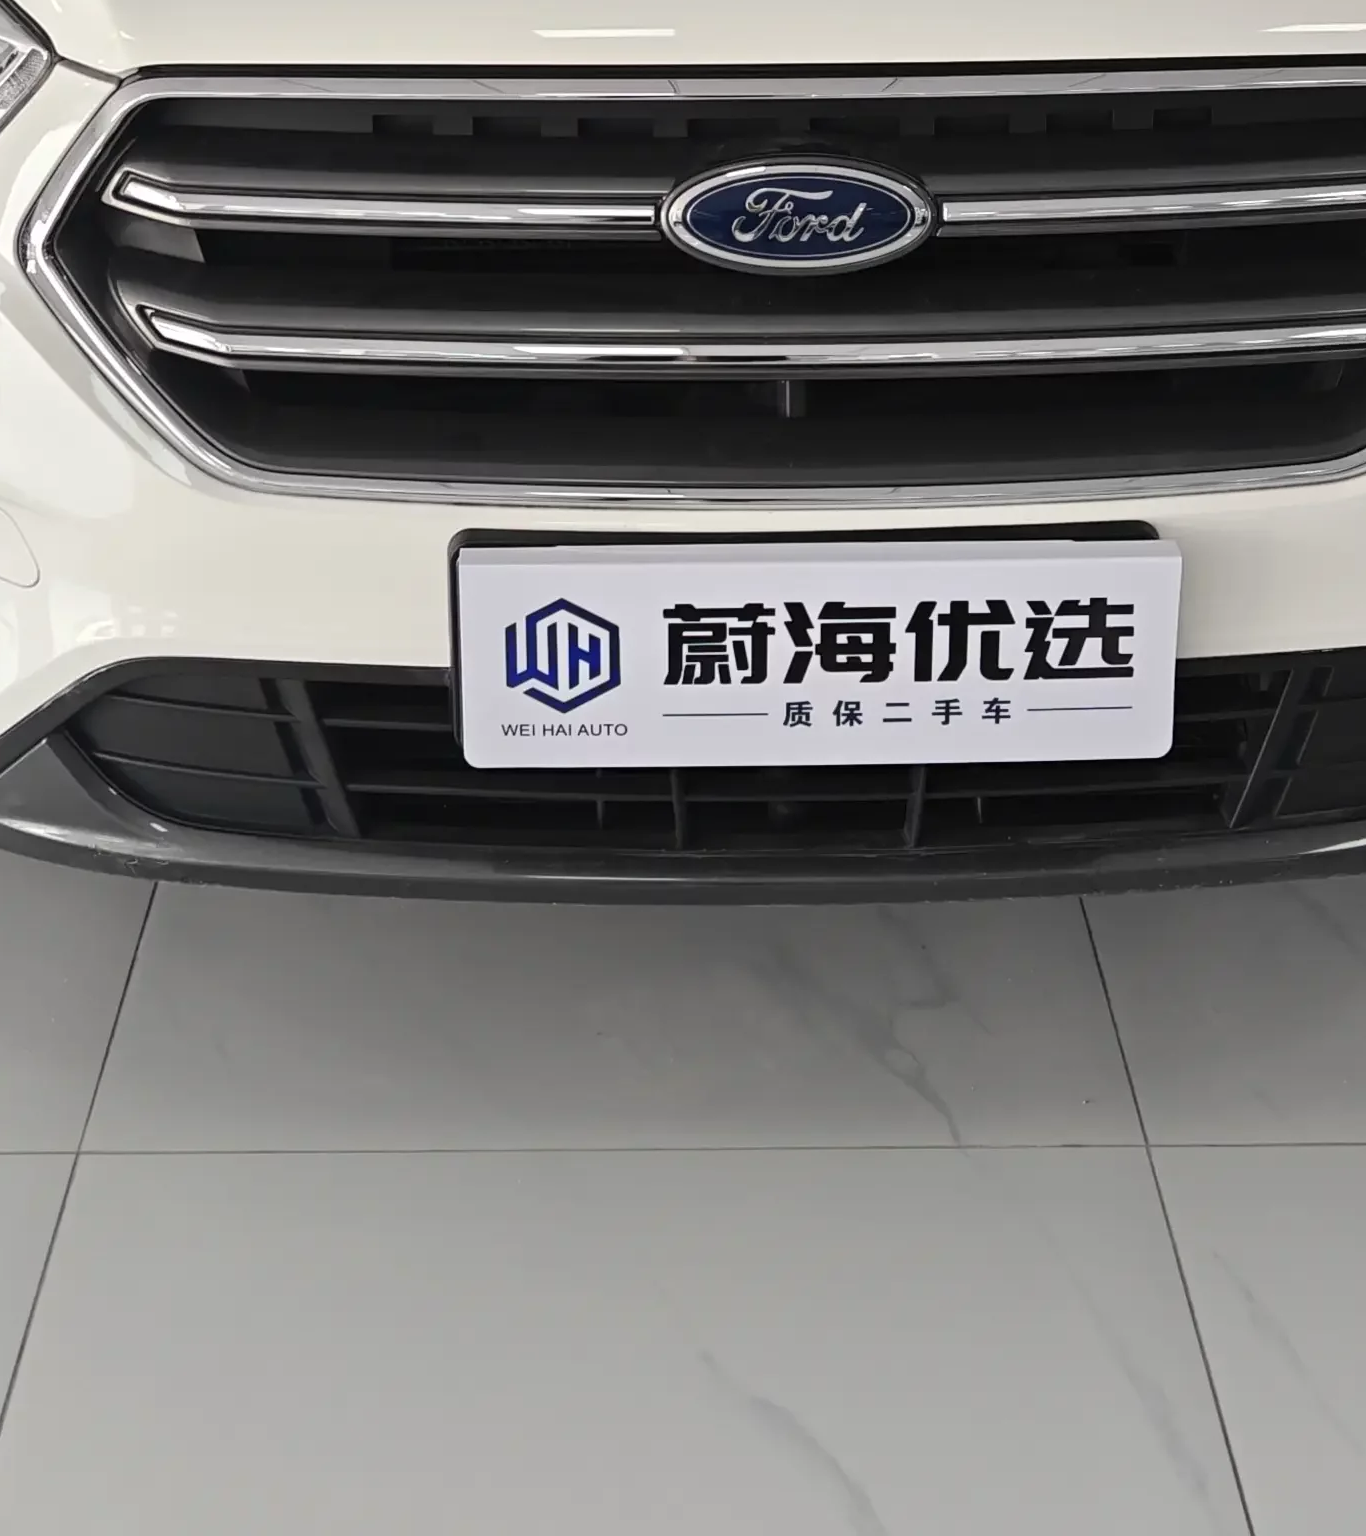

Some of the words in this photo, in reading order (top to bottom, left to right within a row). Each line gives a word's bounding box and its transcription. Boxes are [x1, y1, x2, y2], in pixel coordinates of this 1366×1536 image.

[731, 186, 867, 243] Ford
[661, 596, 1136, 688] 蔚海优选
[501, 723, 536, 737] WEI
[542, 723, 572, 737] HAI
[577, 722, 629, 737] AUTO
[781, 696, 1014, 729] 质保二手车
